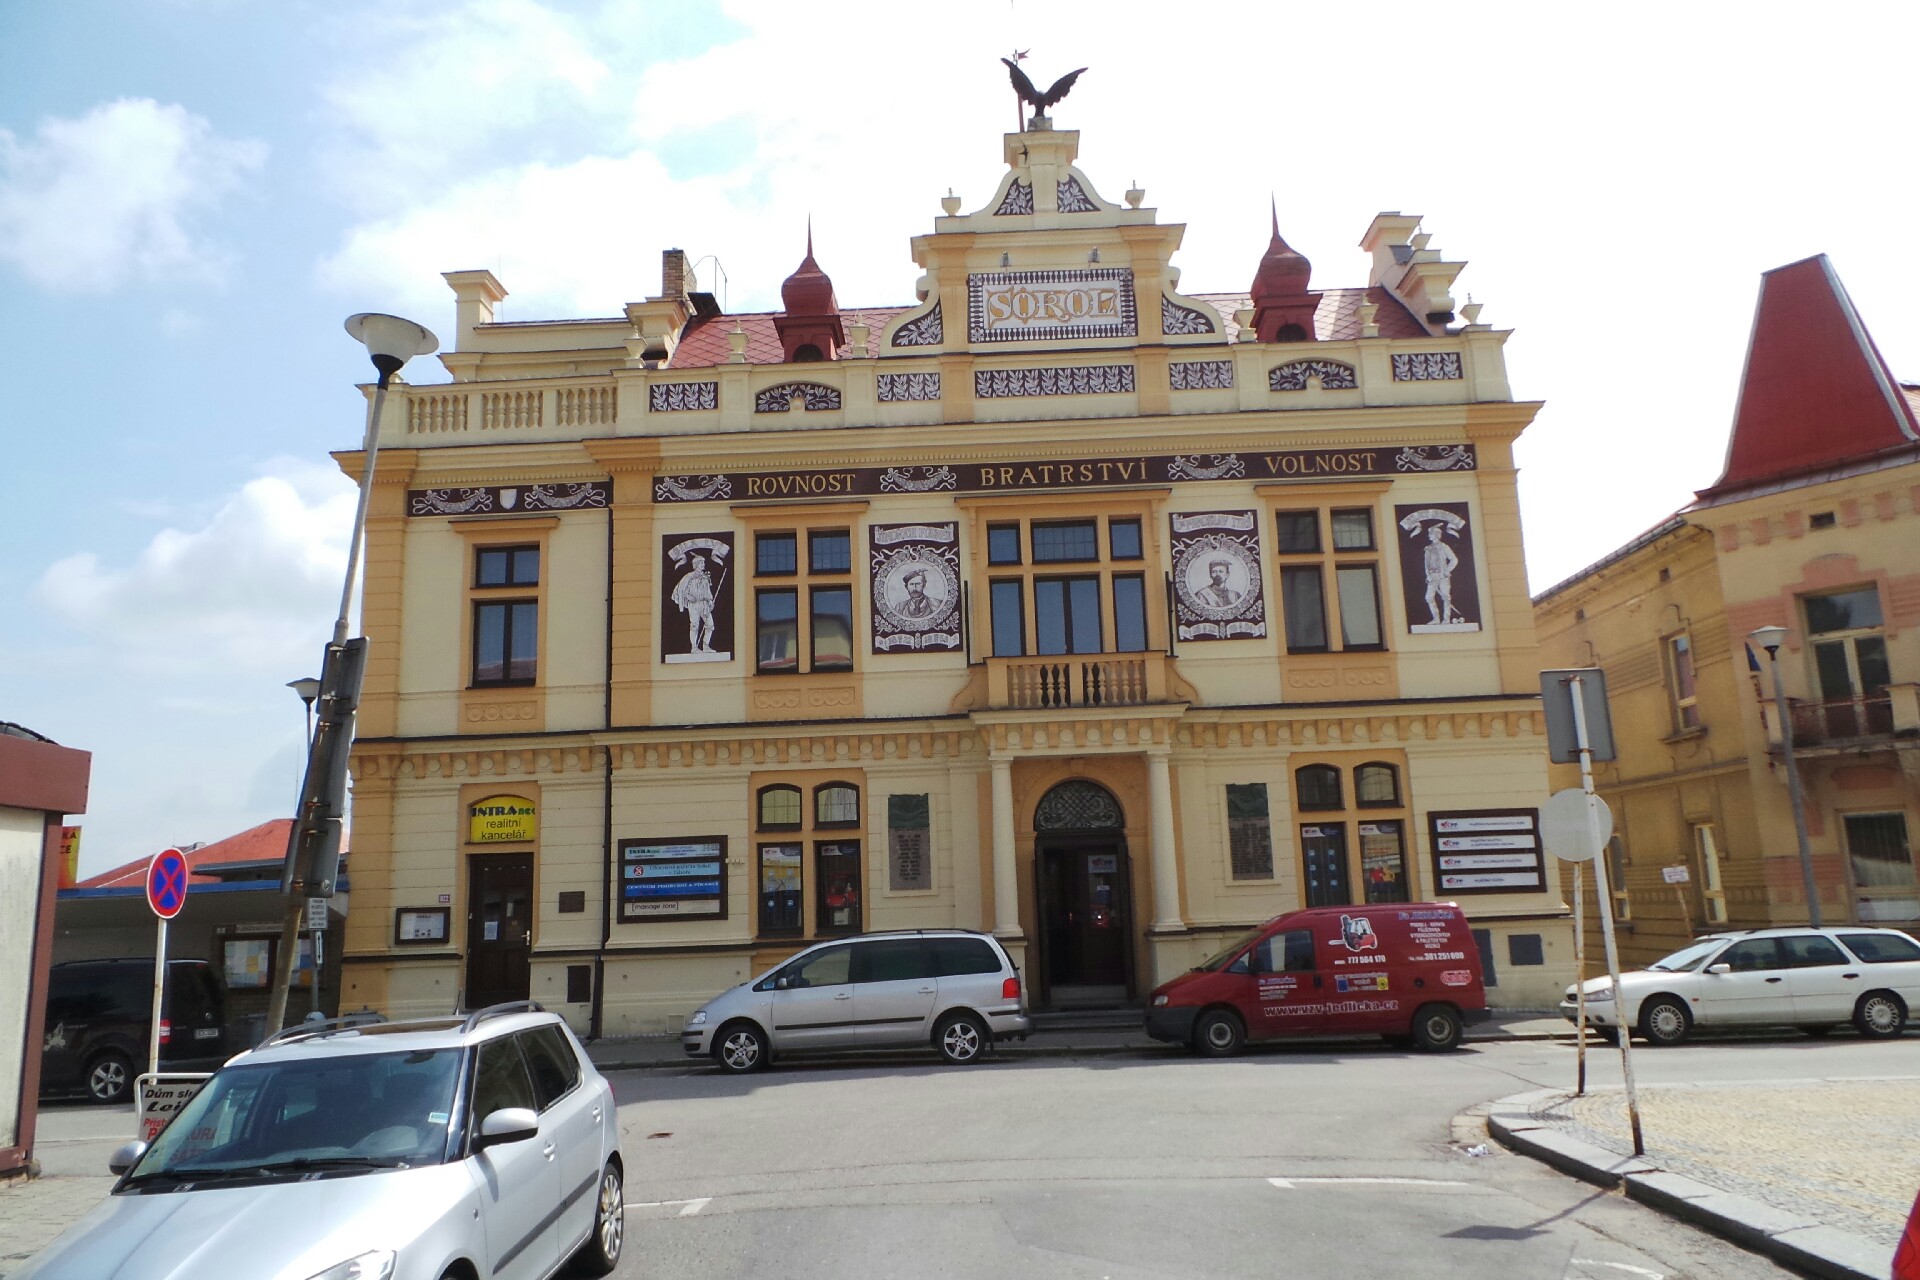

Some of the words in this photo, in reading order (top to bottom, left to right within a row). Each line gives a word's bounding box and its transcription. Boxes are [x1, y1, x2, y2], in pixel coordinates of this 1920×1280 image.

[986, 286, 1119, 328] SOKOL
[980, 458, 1148, 486] BRATRSTVÍ
[1264, 453, 1377, 475] VOLNOST
[747, 473, 857, 496] ROVNOST
[486, 818, 522, 829] realitní
[481, 830, 526, 840] kancelář
[1347, 956, 1359, 964] 777
[144, 1087, 174, 1099] Dům
